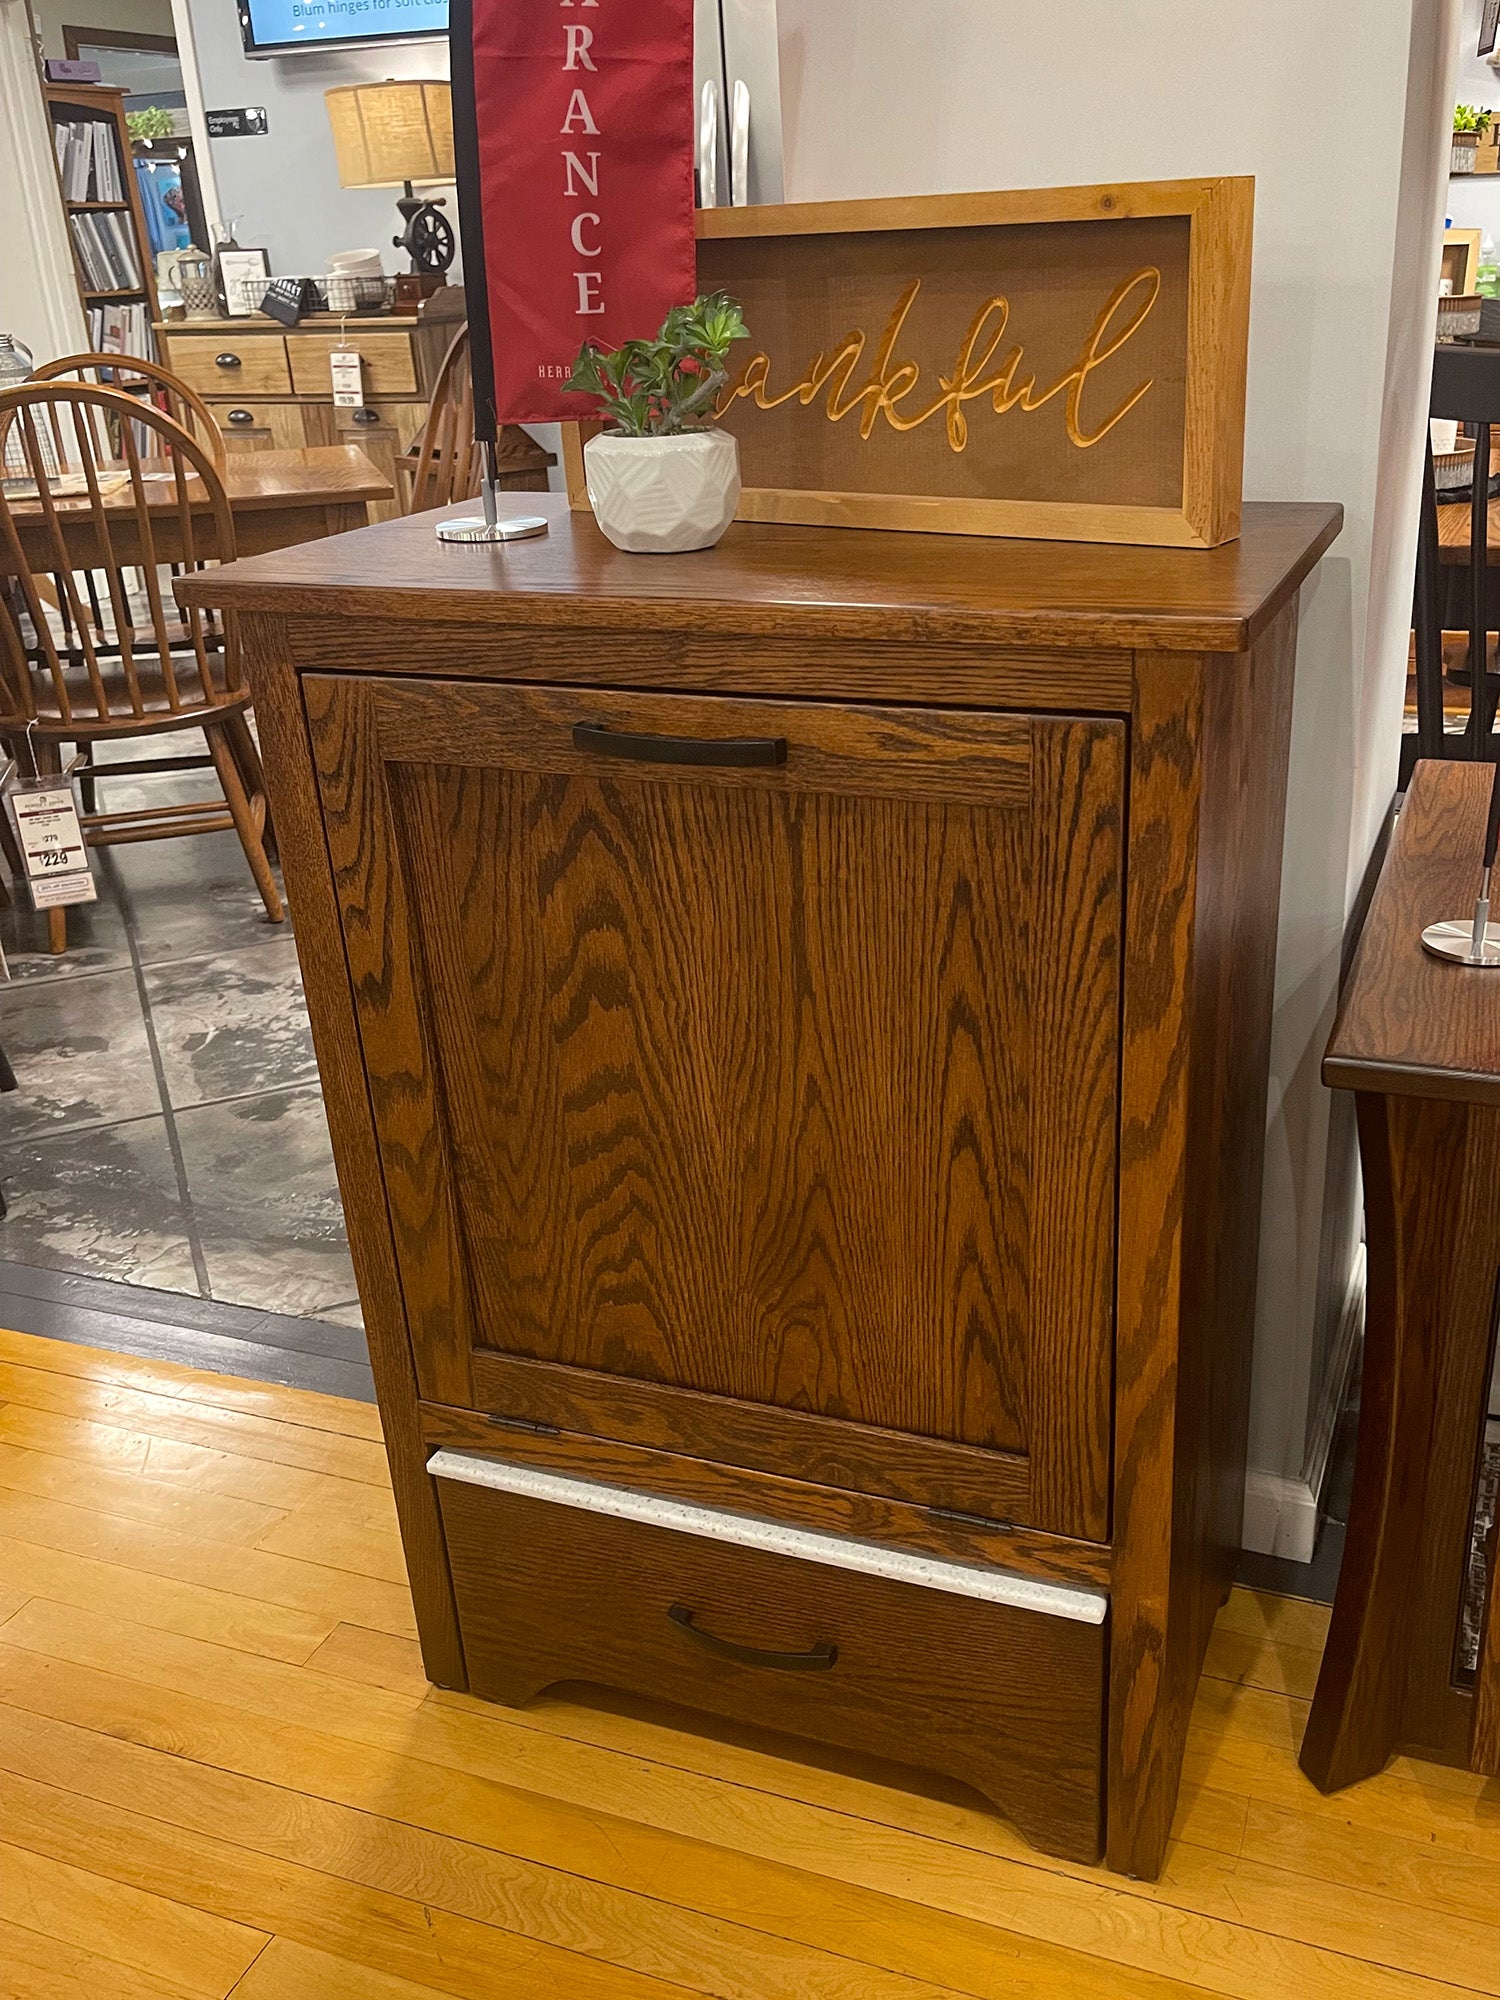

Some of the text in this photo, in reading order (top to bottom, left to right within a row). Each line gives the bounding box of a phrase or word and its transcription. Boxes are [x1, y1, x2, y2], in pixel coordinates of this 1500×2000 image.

[292, 4, 325, 17] Blum
[327, 1, 370, 15] hinges
[372, 0, 392, 9] for
[559, 0, 605, 315] RANCE
[712, 266, 1160, 453] ankful
